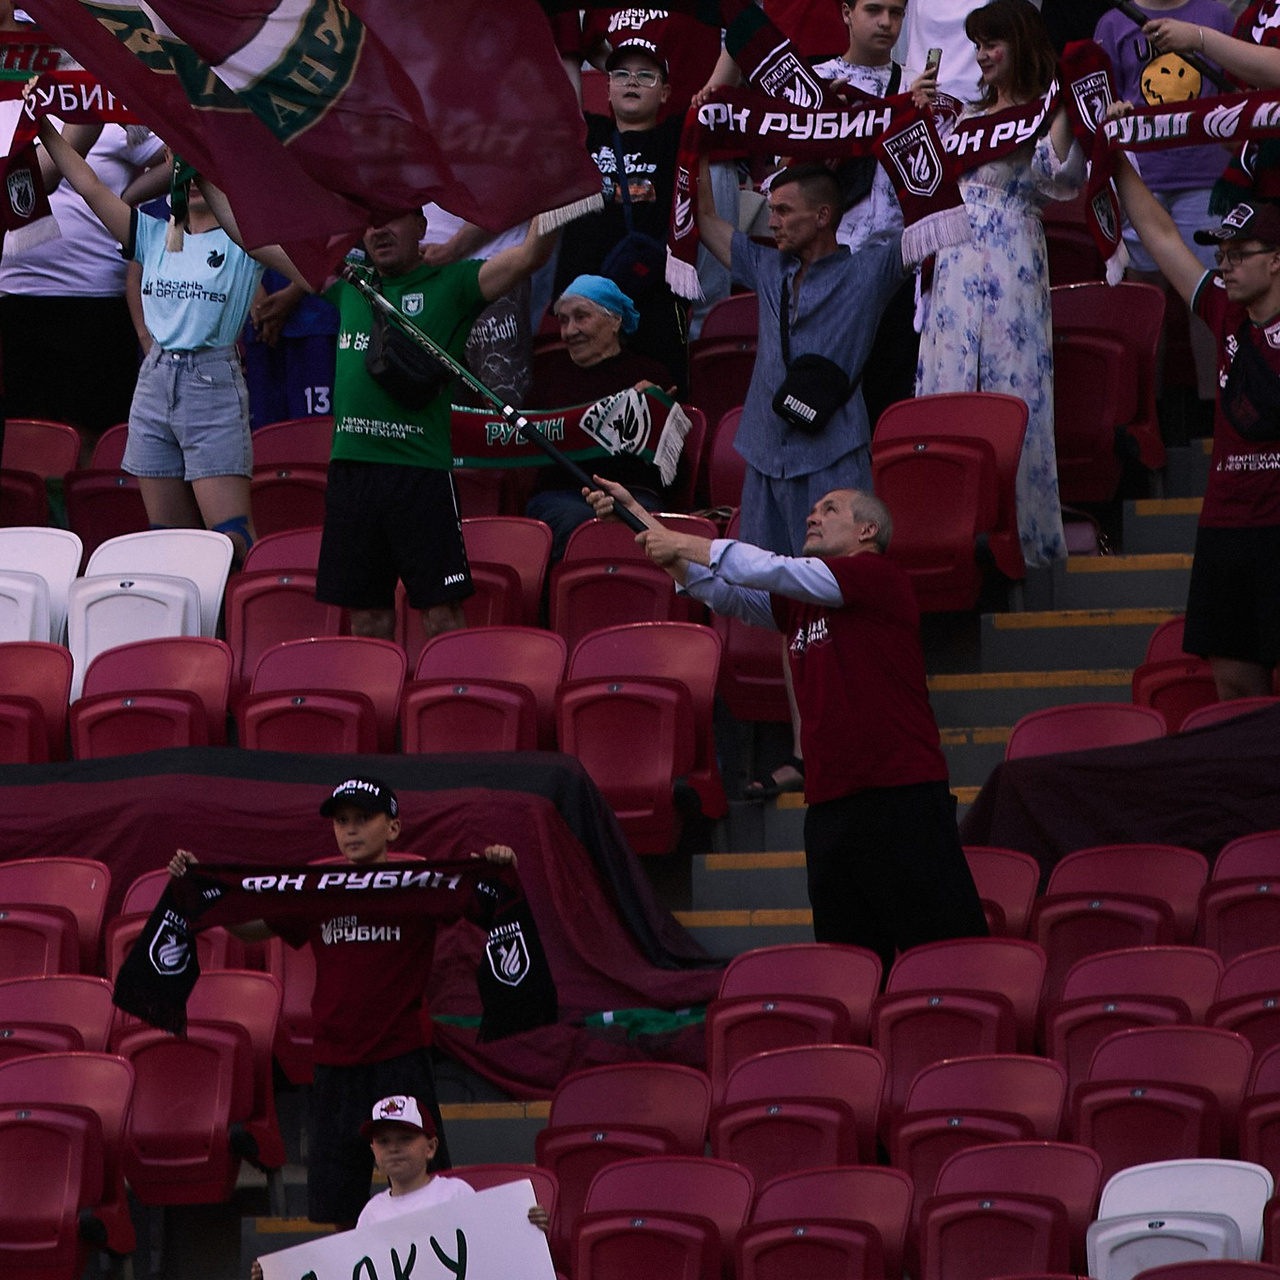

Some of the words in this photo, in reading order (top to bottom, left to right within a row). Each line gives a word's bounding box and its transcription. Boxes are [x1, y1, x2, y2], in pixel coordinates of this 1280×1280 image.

[698, 102, 751, 134] ФК
[758, 106, 892, 140] РУБИН
[155, 287, 227, 304] ОРГСИНТЕЗ
[156, 279, 203, 291] КАЗАНЬ
[304, 385, 331, 415] 13
[783, 393, 818, 422] PUMA
[486, 416, 566, 446] РУИН
[444, 571, 466, 587] JAKO
[241, 873, 308, 892] ФК
[317, 870, 462, 891] РУБИН
[332, 924, 401, 944] РУБИН
